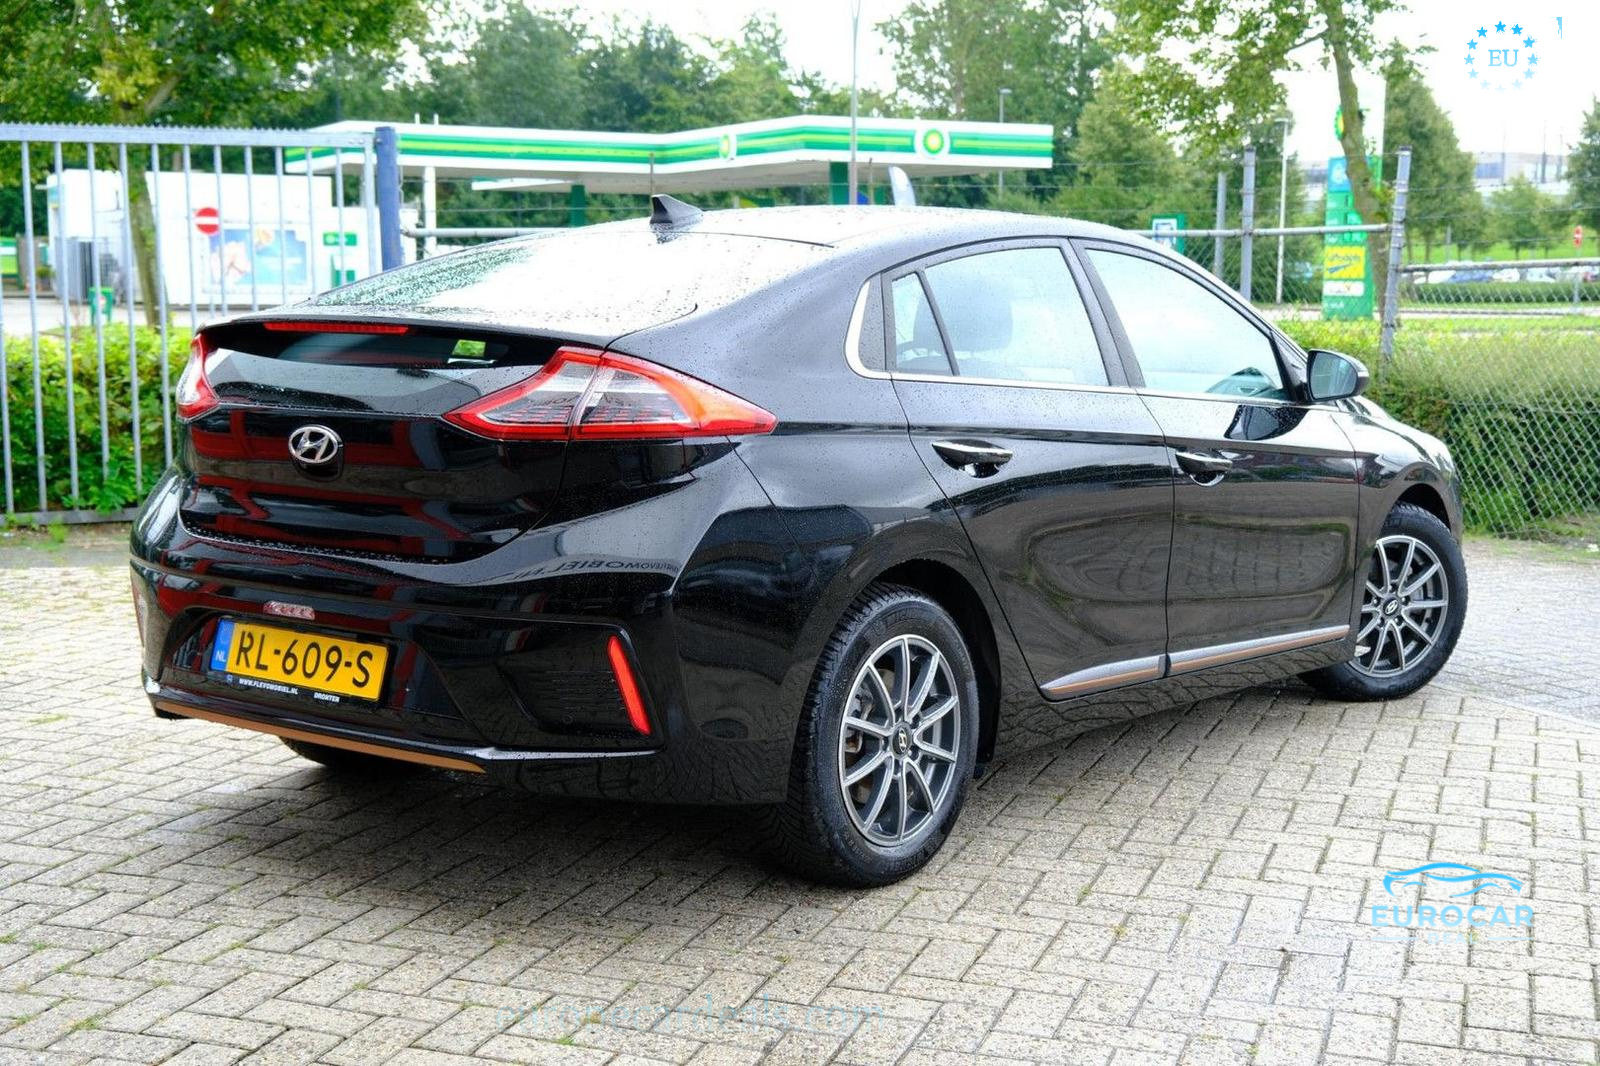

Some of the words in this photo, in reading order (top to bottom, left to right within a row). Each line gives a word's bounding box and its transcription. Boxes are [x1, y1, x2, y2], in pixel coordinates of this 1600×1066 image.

[215, 650, 226, 662] NL
[235, 630, 374, 688] RL-609-S
[313, 691, 340, 703] DRONTEN
